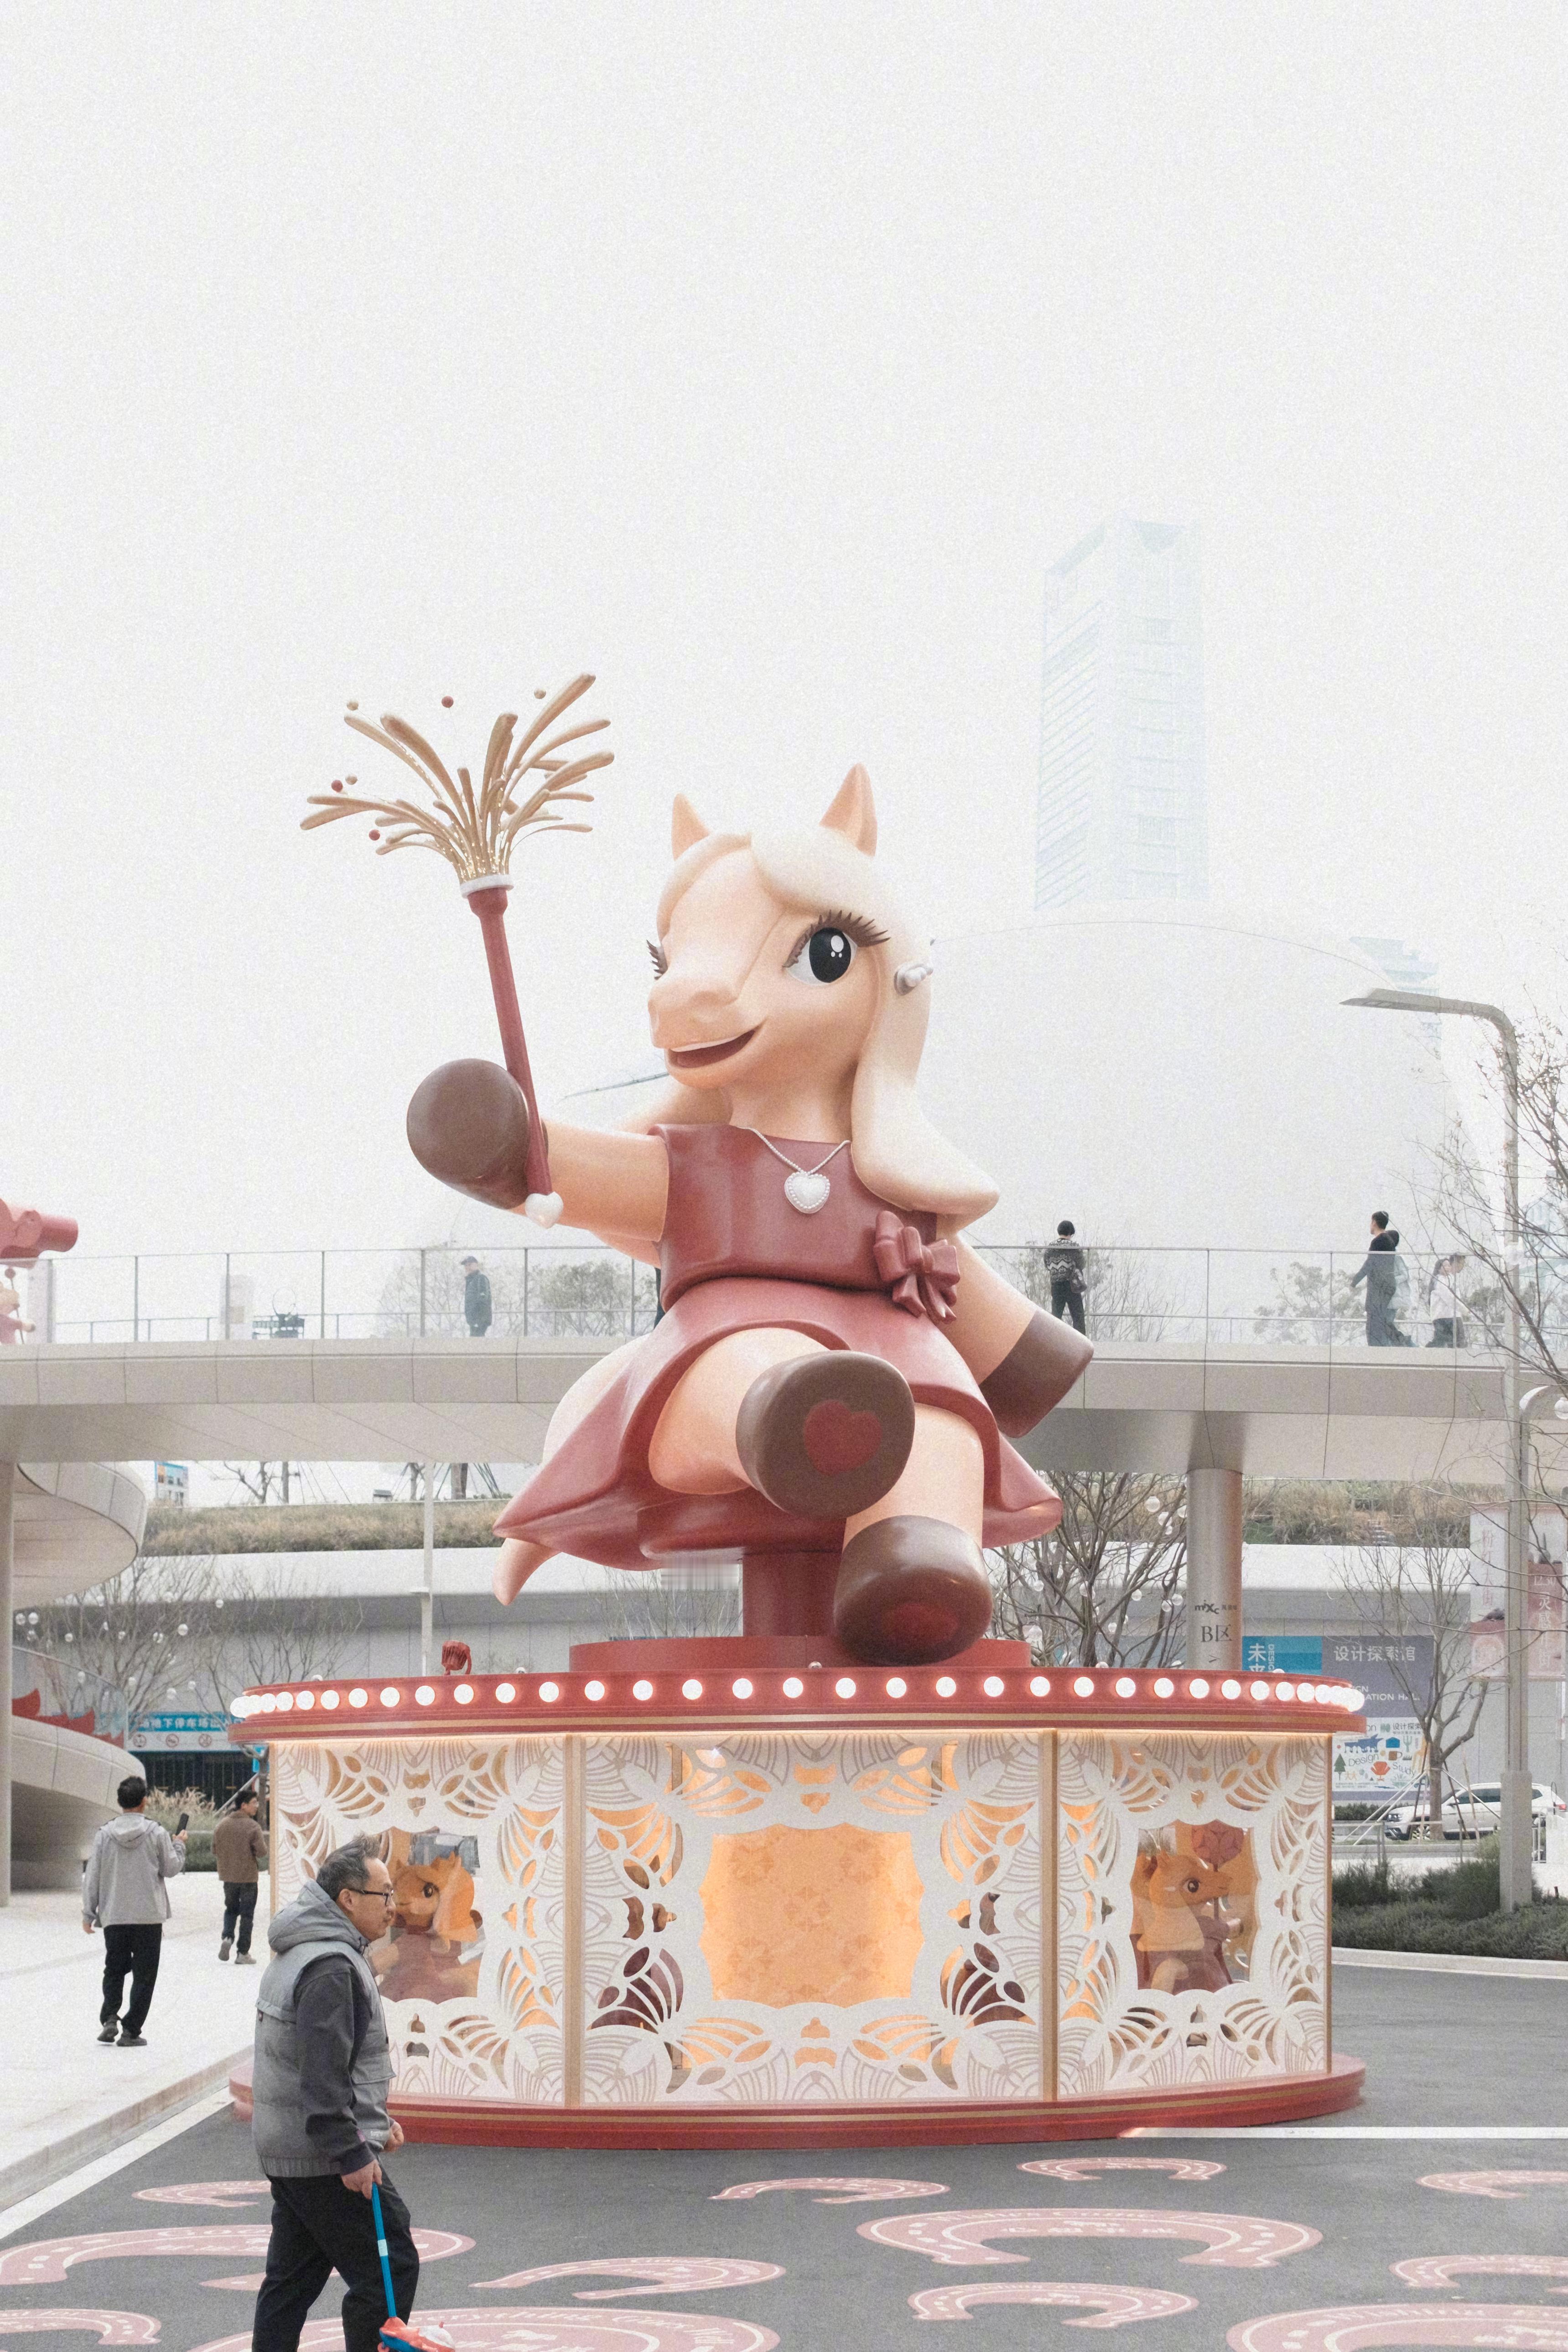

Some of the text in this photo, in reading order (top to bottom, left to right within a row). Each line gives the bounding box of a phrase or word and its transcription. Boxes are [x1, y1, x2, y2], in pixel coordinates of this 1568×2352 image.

[1201, 1624, 1232, 1642] B区
[1334, 1645, 1416, 1662] 设计探索馆
[1348, 1753, 1380, 1766] Design
[1392, 1761, 1416, 1778] Study
